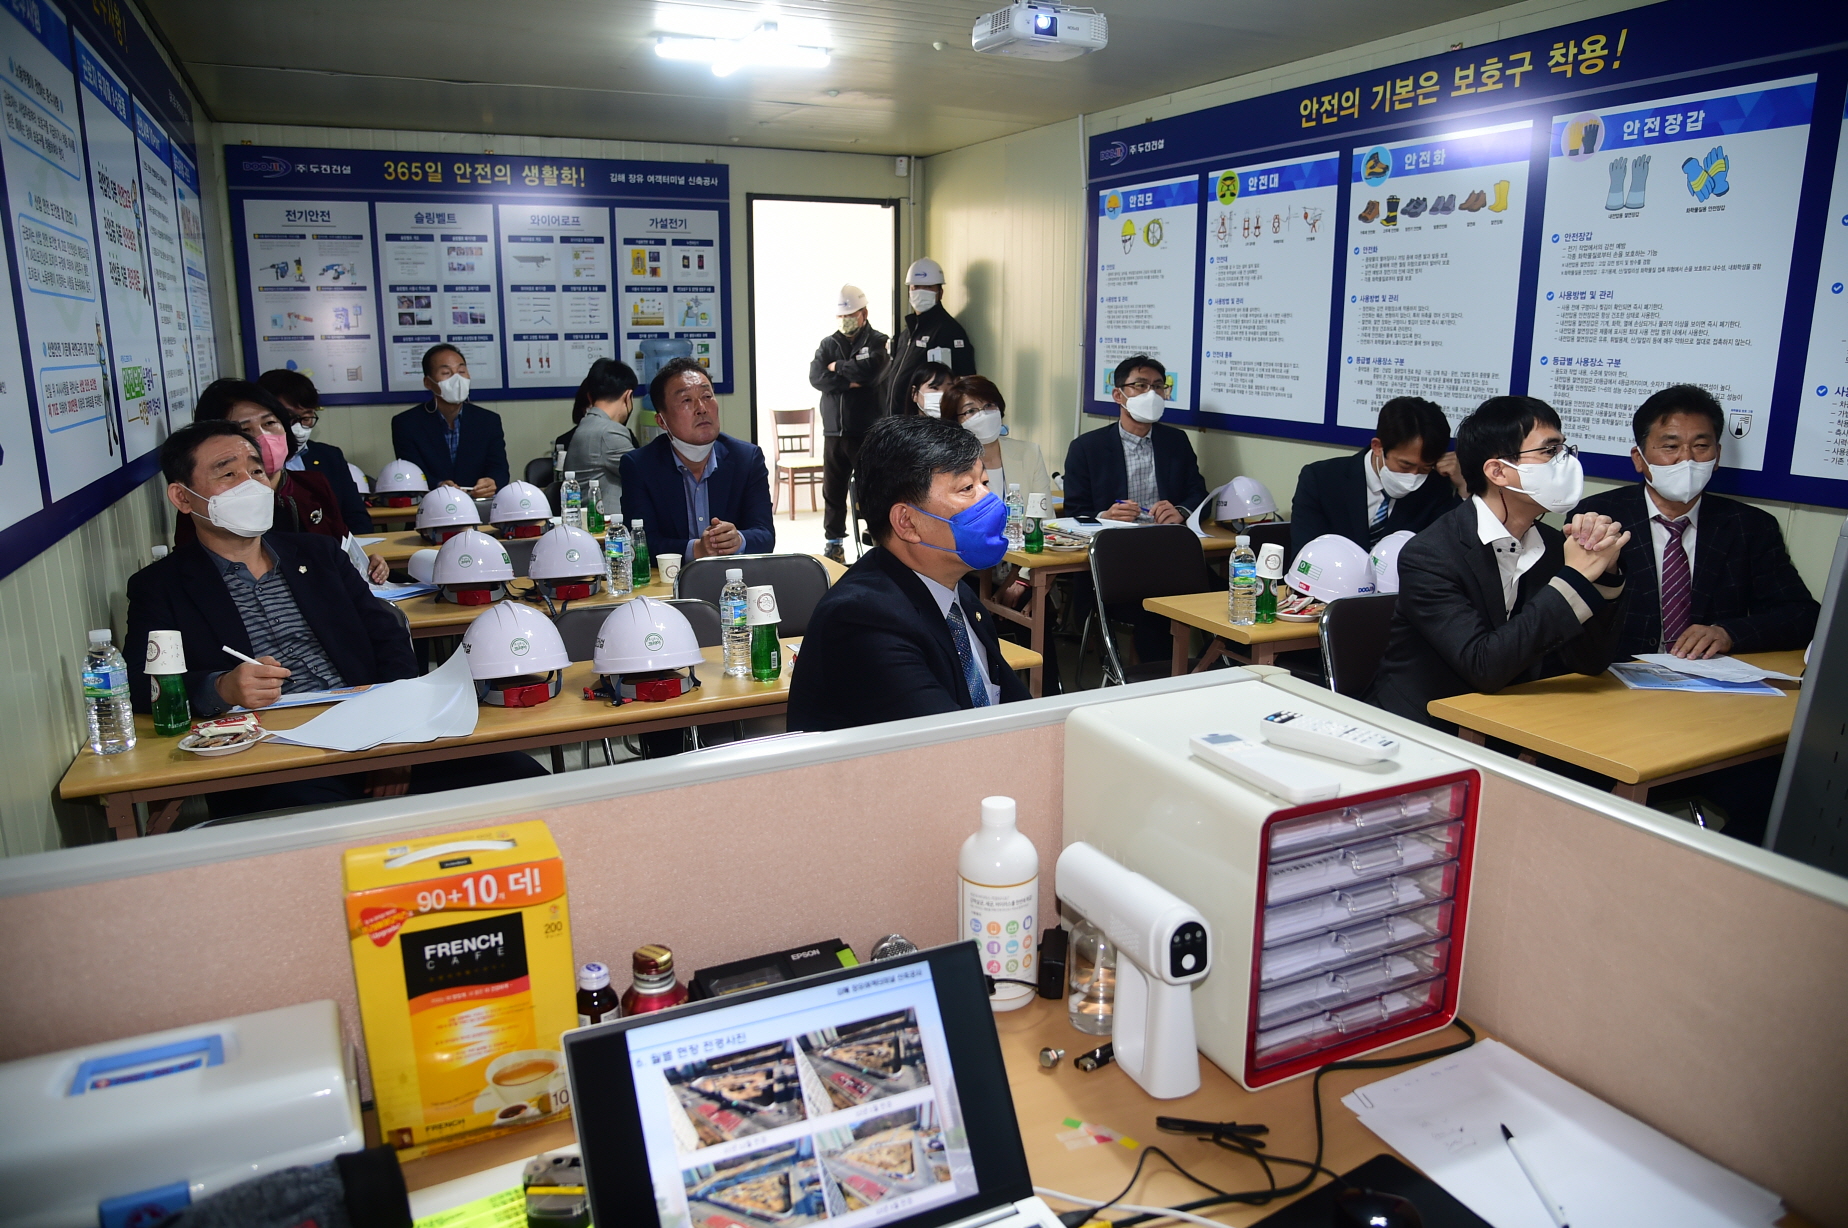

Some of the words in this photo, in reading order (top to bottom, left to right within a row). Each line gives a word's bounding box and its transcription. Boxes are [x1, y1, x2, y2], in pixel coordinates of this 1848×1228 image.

[1299, 87, 1360, 128] 안전의
[1370, 71, 1441, 112] 기본은
[1450, 51, 1533, 97] 보호구
[1547, 29, 1628, 78] 착용!
[1622, 109, 1706, 141] 안전장갑
[1404, 149, 1446, 170] 안전화
[384, 161, 443, 183] 365일
[454, 162, 511, 184] 안전의
[522, 165, 586, 188] 생활화!
[610, 173, 626, 183] 김해
[628, 174, 644, 185] 장유
[647, 174, 685, 185] 여객터미널
[688, 176, 718, 187] 신축공사
[1248, 173, 1279, 192] 안전대
[1129, 193, 1153, 208] 안전모
[285, 209, 331, 223] 전기안전
[414, 211, 457, 225] 슬링벨트
[530, 214, 581, 227] 와이어로프
[649, 217, 687, 230] 가설전기
[1564, 232, 1592, 242] 안전장갑
[1363, 246, 1378, 255] 안전화
[1360, 295, 1380, 303] 사용방법
[1559, 291, 1586, 301] 사용방법
[1589, 291, 1596, 300] 및
[1599, 290, 1614, 299] 관리
[1356, 356, 1370, 364] 등급별
[1372, 357, 1392, 365] 사용장소
[1394, 358, 1404, 366] 구분
[1553, 357, 1573, 365] 등급별
[1575, 358, 1604, 367] 사용장소
[1606, 359, 1621, 368] 구분
[508, 868, 541, 895] 더!
[544, 921, 563, 935] 200
[424, 932, 504, 961] FRENCH
[790, 949, 820, 961] EPSON
[677, 1043, 699, 1060] 현장
[425, 1118, 466, 1133] FRENCH
